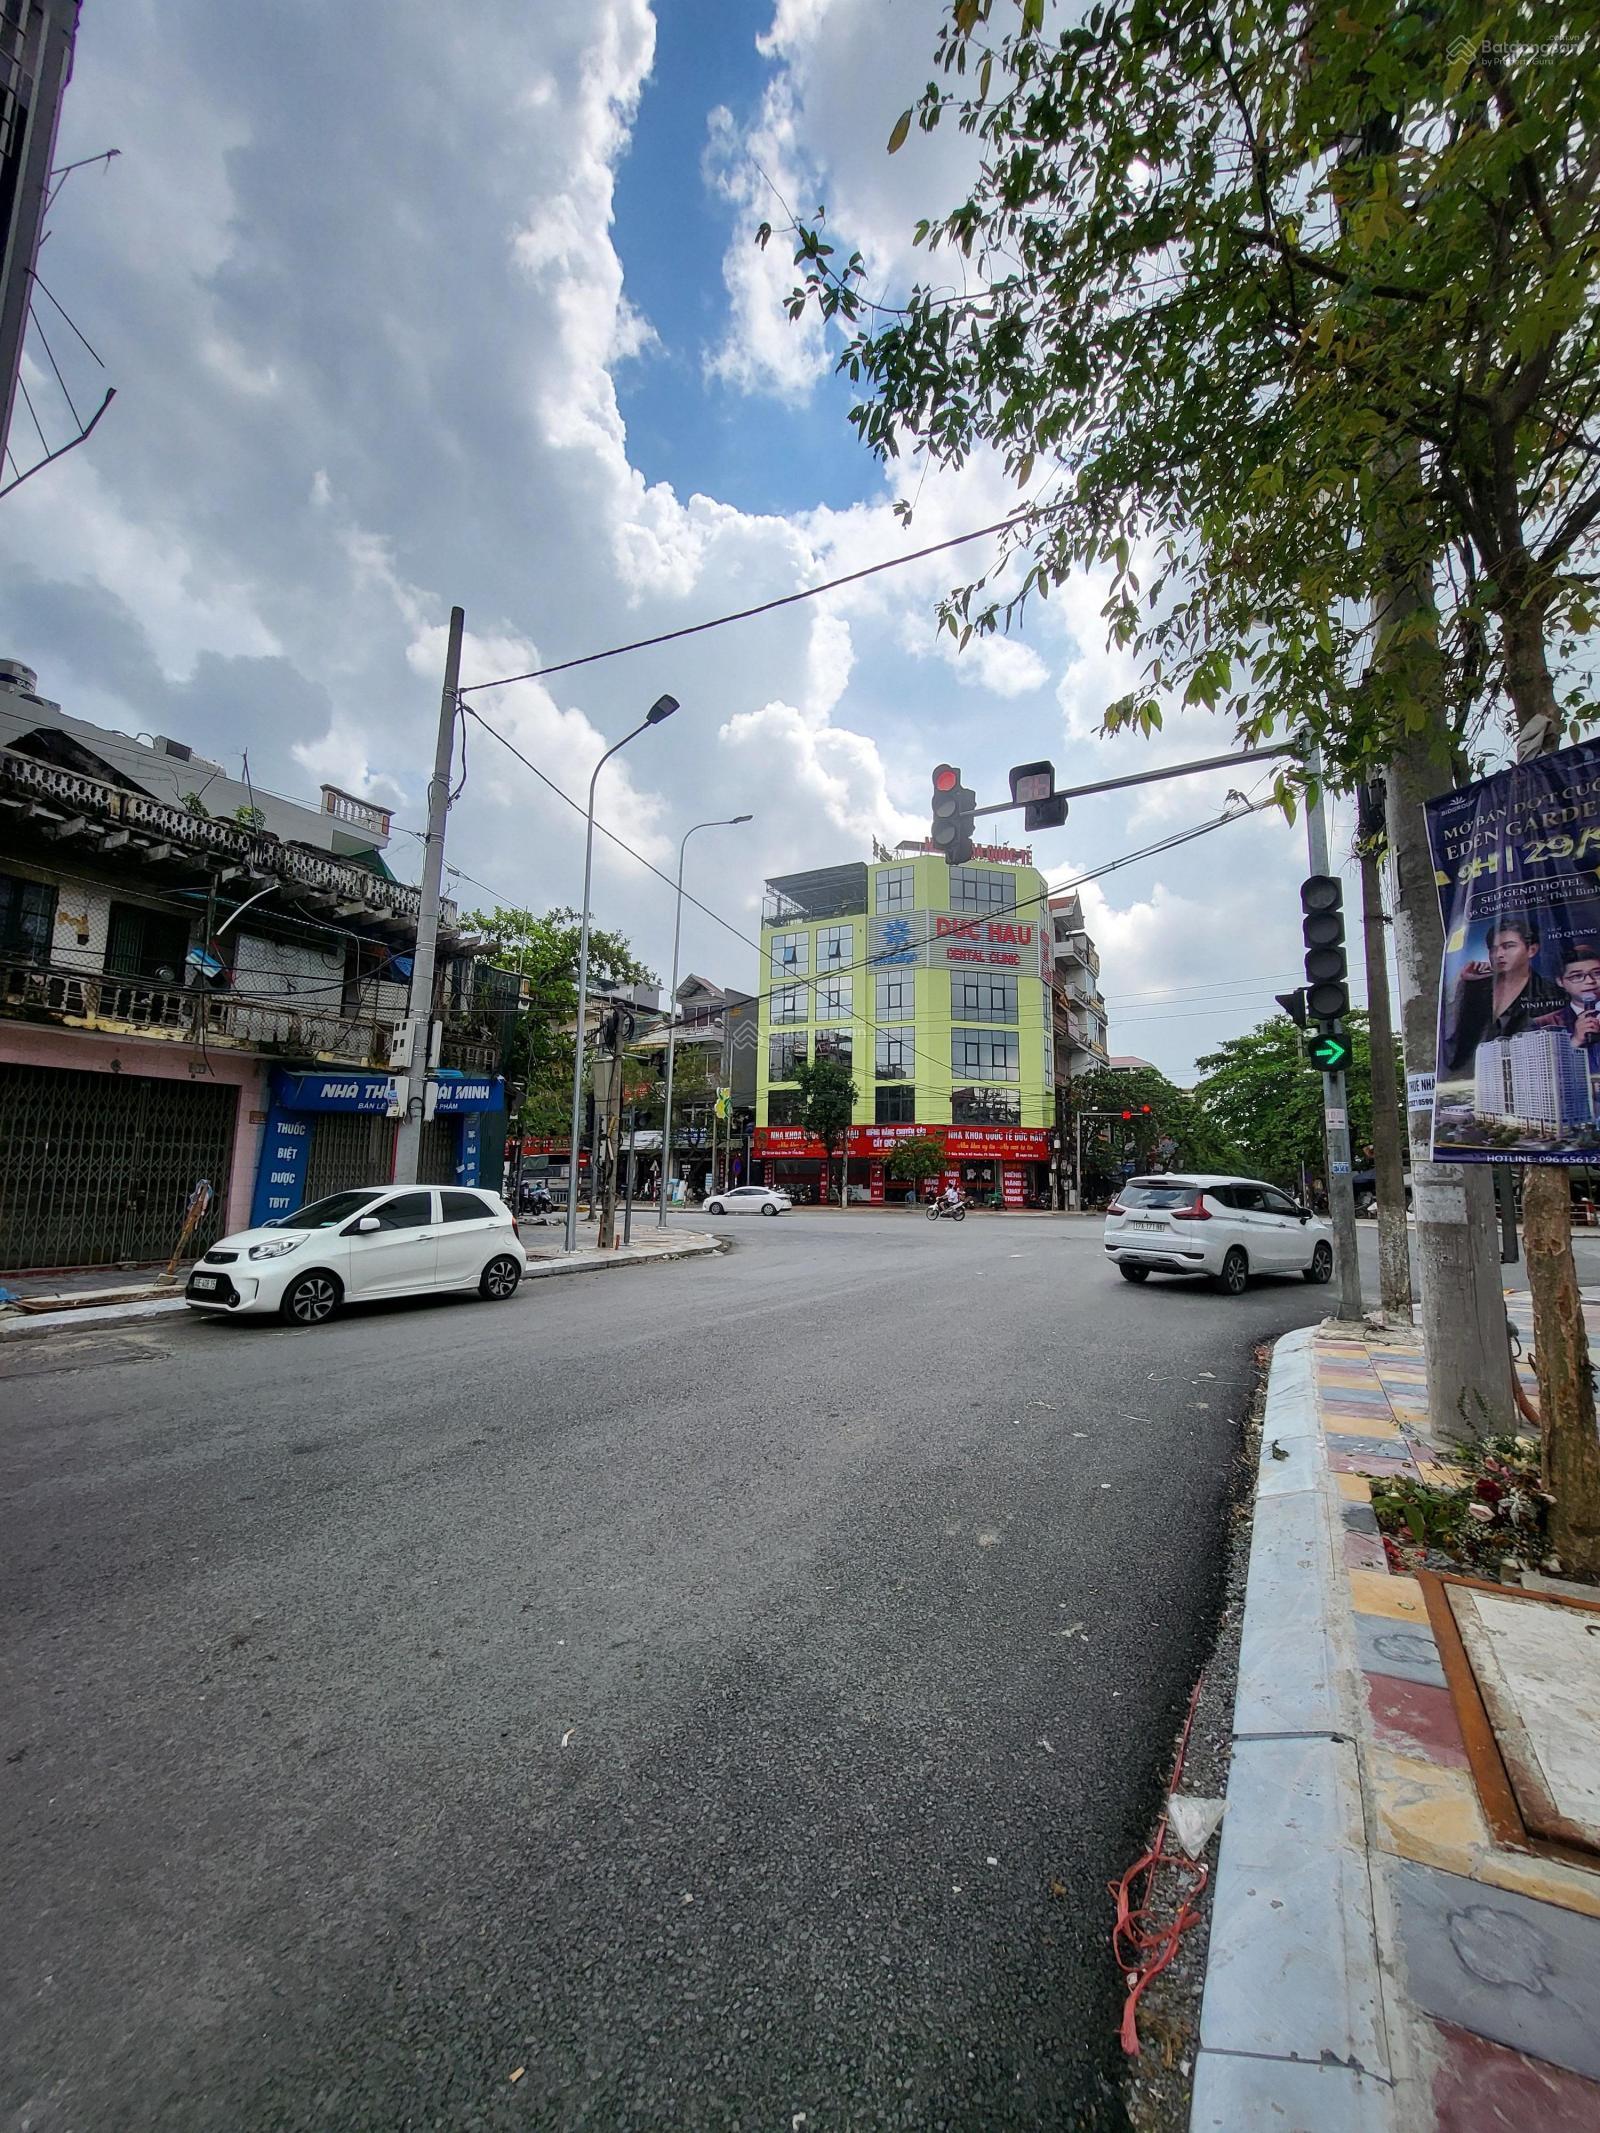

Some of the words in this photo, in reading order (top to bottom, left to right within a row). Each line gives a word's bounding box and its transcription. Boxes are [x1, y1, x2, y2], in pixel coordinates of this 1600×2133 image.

[1447, 827, 1499, 861] EDEN
[1458, 850, 1499, 885] 9H
[1481, 885, 1537, 904] SELEGEND
[1480, 901, 1511, 915] Quang
[1564, 927, 1597, 938] QUANG
[947, 948, 984, 962] DENTAL
[990, 951, 1021, 965] CLINIC
[321, 1081, 359, 1099] NHÀ
[455, 1085, 489, 1099] MINH
[277, 1121, 306, 1135] THUỐC
[771, 1131, 783, 1139] NHA
[948, 1130, 962, 1139] NHA
[964, 1131, 983, 1140] KHOA
[277, 1146, 298, 1161] BIỆT
[1487, 1154, 1537, 1163] HOTLINE:
[1540, 1155, 1560, 1163] 096
[269, 1197, 290, 1209] TBYT
